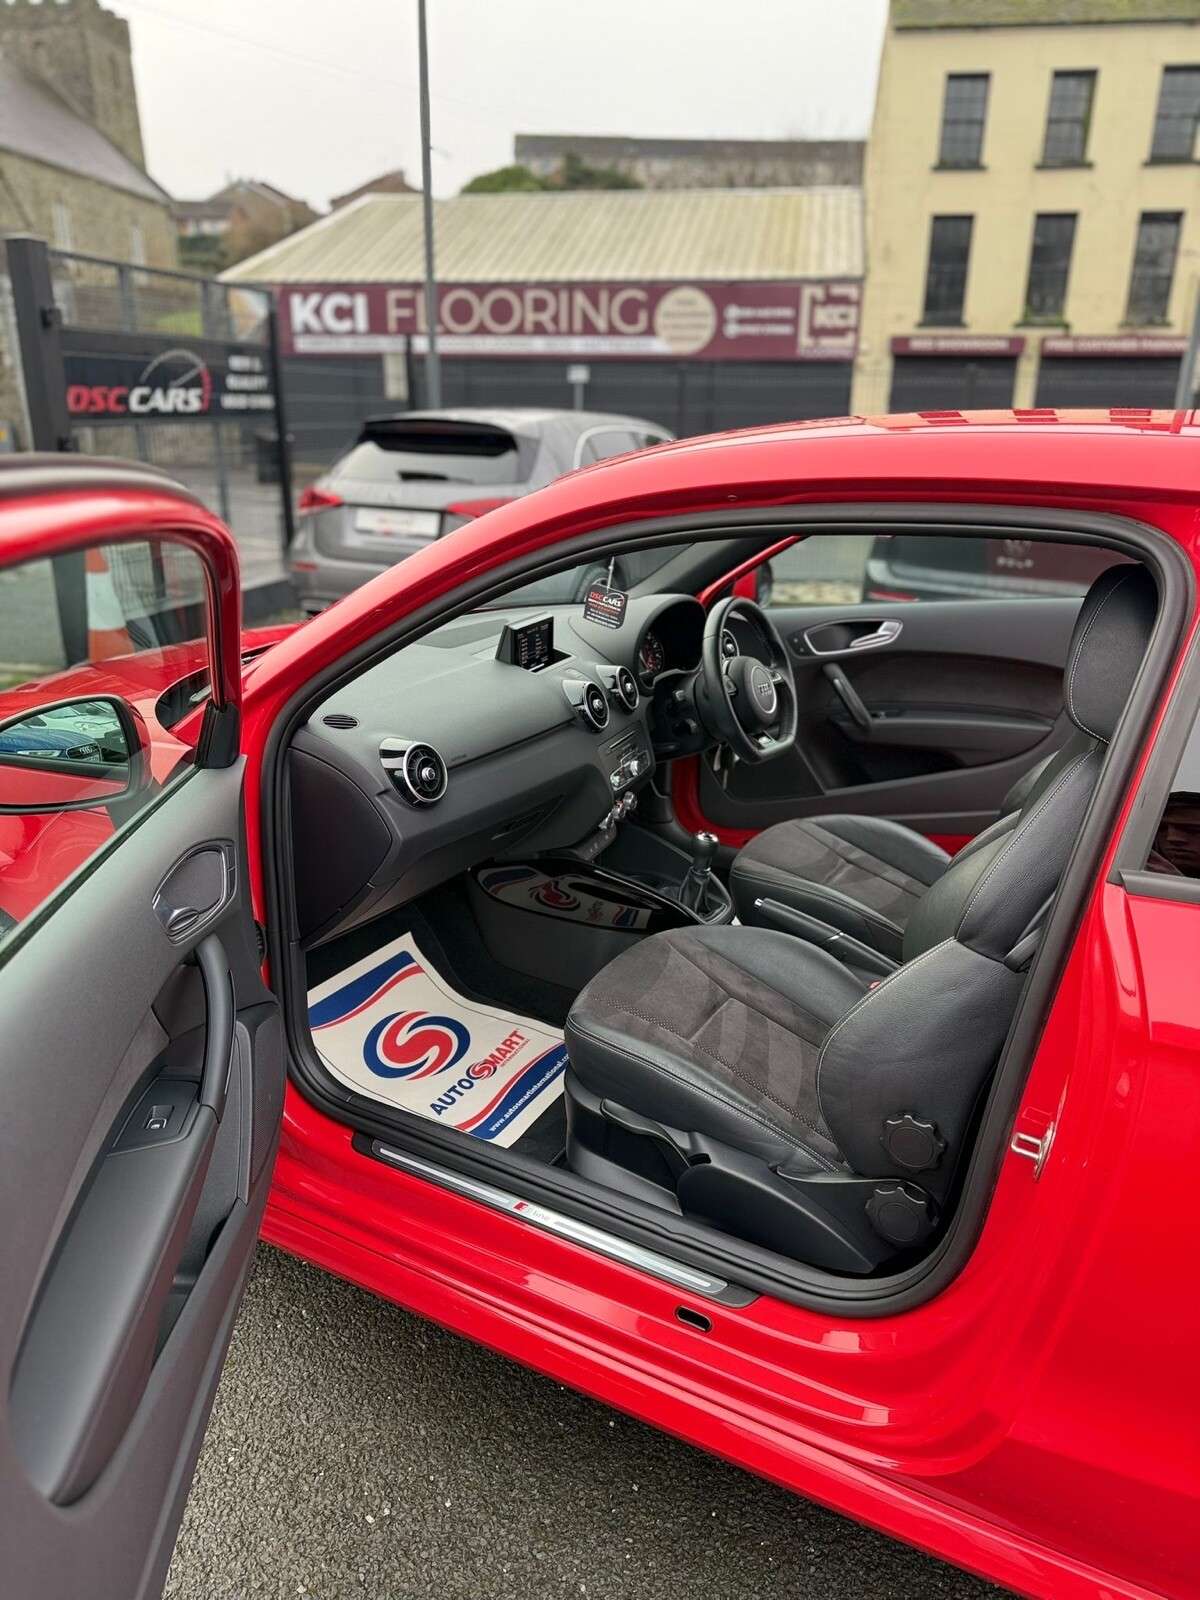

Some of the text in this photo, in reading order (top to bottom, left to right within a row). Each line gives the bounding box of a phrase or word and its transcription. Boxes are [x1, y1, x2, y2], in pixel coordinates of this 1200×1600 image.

[289, 292, 369, 334] KCI
[386, 288, 649, 334] FLOORING
[488, 1053, 570, 1132] www.autosmartinternational.co
